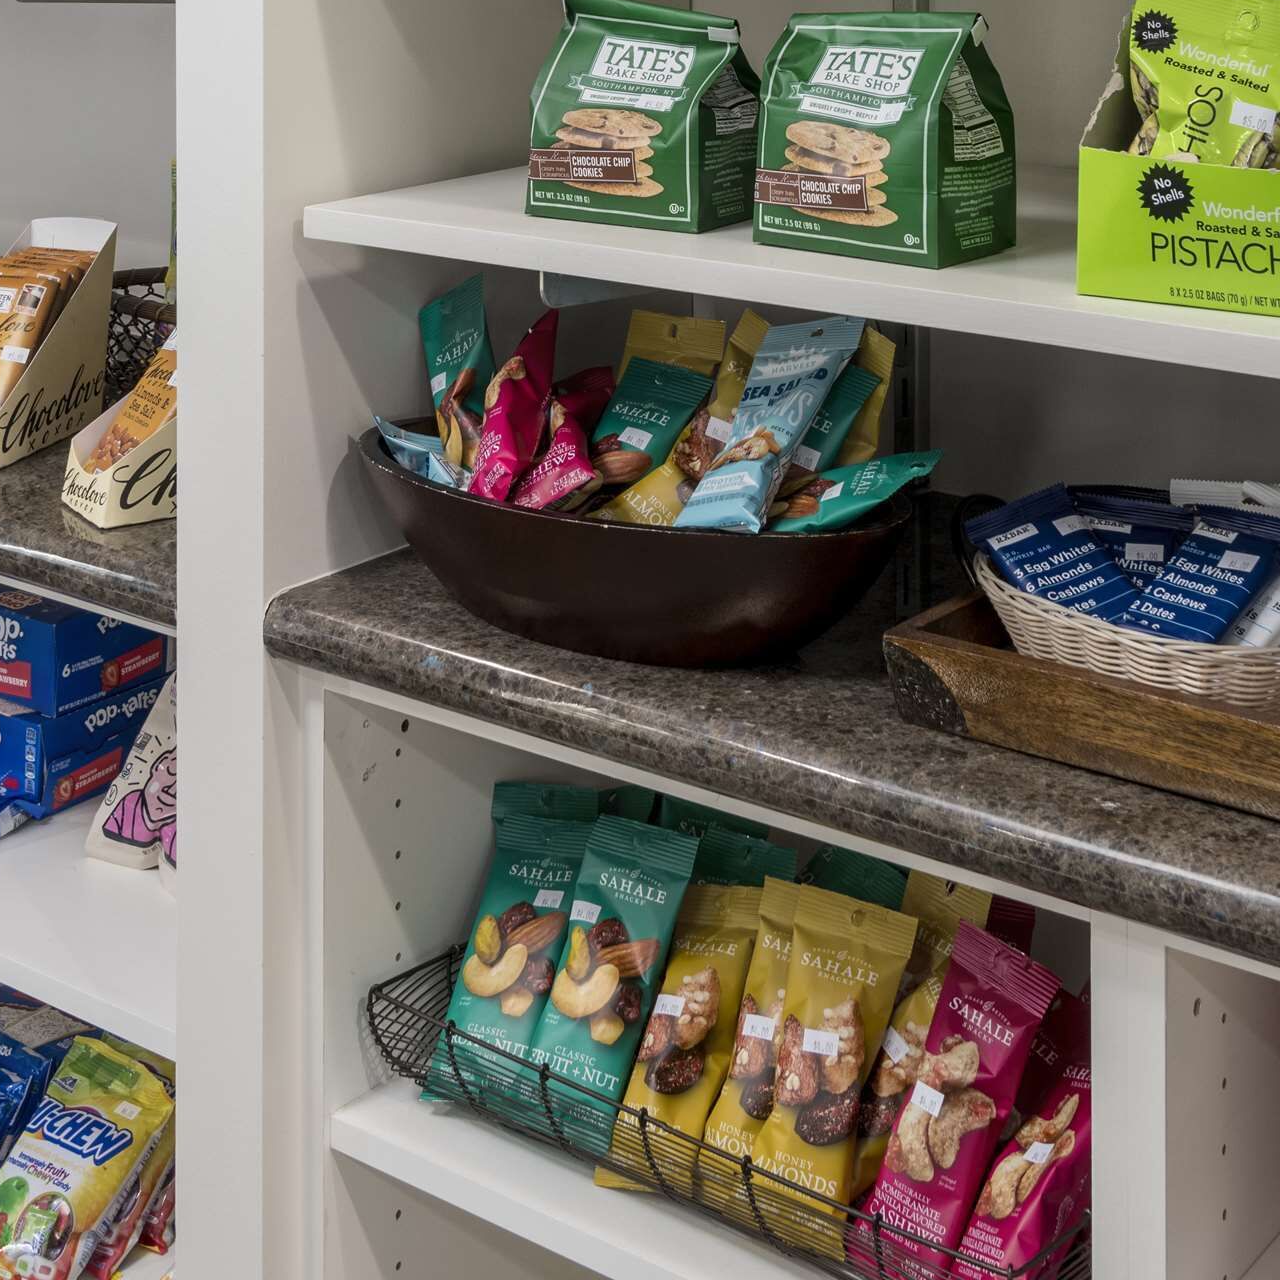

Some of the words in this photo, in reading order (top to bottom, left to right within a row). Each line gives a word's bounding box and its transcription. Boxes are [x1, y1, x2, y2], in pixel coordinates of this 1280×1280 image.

[1147, 20, 1162, 29] No
[1142, 29, 1170, 40] Shells
[604, 42, 690, 74] TATE'S
[825, 50, 917, 81] TATE'S
[605, 67, 638, 79] BAKE
[640, 71, 673, 84] SHOP
[824, 72, 860, 86] BAKE
[864, 78, 900, 93] SHOP
[1230, 74, 1270, 93] Salted
[572, 156, 612, 168] CHOCOLATE
[613, 157, 631, 168] CHIP
[572, 167, 603, 178] COOKIES
[800, 182, 840, 195] CHOCOLATE
[841, 183, 861, 195] CHIP
[1150, 188, 1185, 206] Shells
[801, 194, 832, 205] COOKIES
[1195, 221, 1248, 237] Roasted
[1205, 291, 1225, 302] BAGS
[741, 384, 771, 402] SEA
[995, 525, 1031, 544] RXBAR
[1024, 559, 1051, 575] Egg
[1051, 541, 1096, 565] Whites
[1036, 560, 1093, 588] Almonds
[1046, 574, 1105, 601] Cashews
[1141, 601, 1176, 620] Dates
[120, 651, 161, 675] STRAWBERRY
[509, 864, 573, 883] SAHALE
[599, 872, 667, 905] SAHALE
[800, 951, 880, 987] SAHALE
[554, 1045, 596, 1066] CLASSIC
[774, 1151, 814, 1168] HONEY
[882, 1180, 941, 1220] POMEGRANATE
